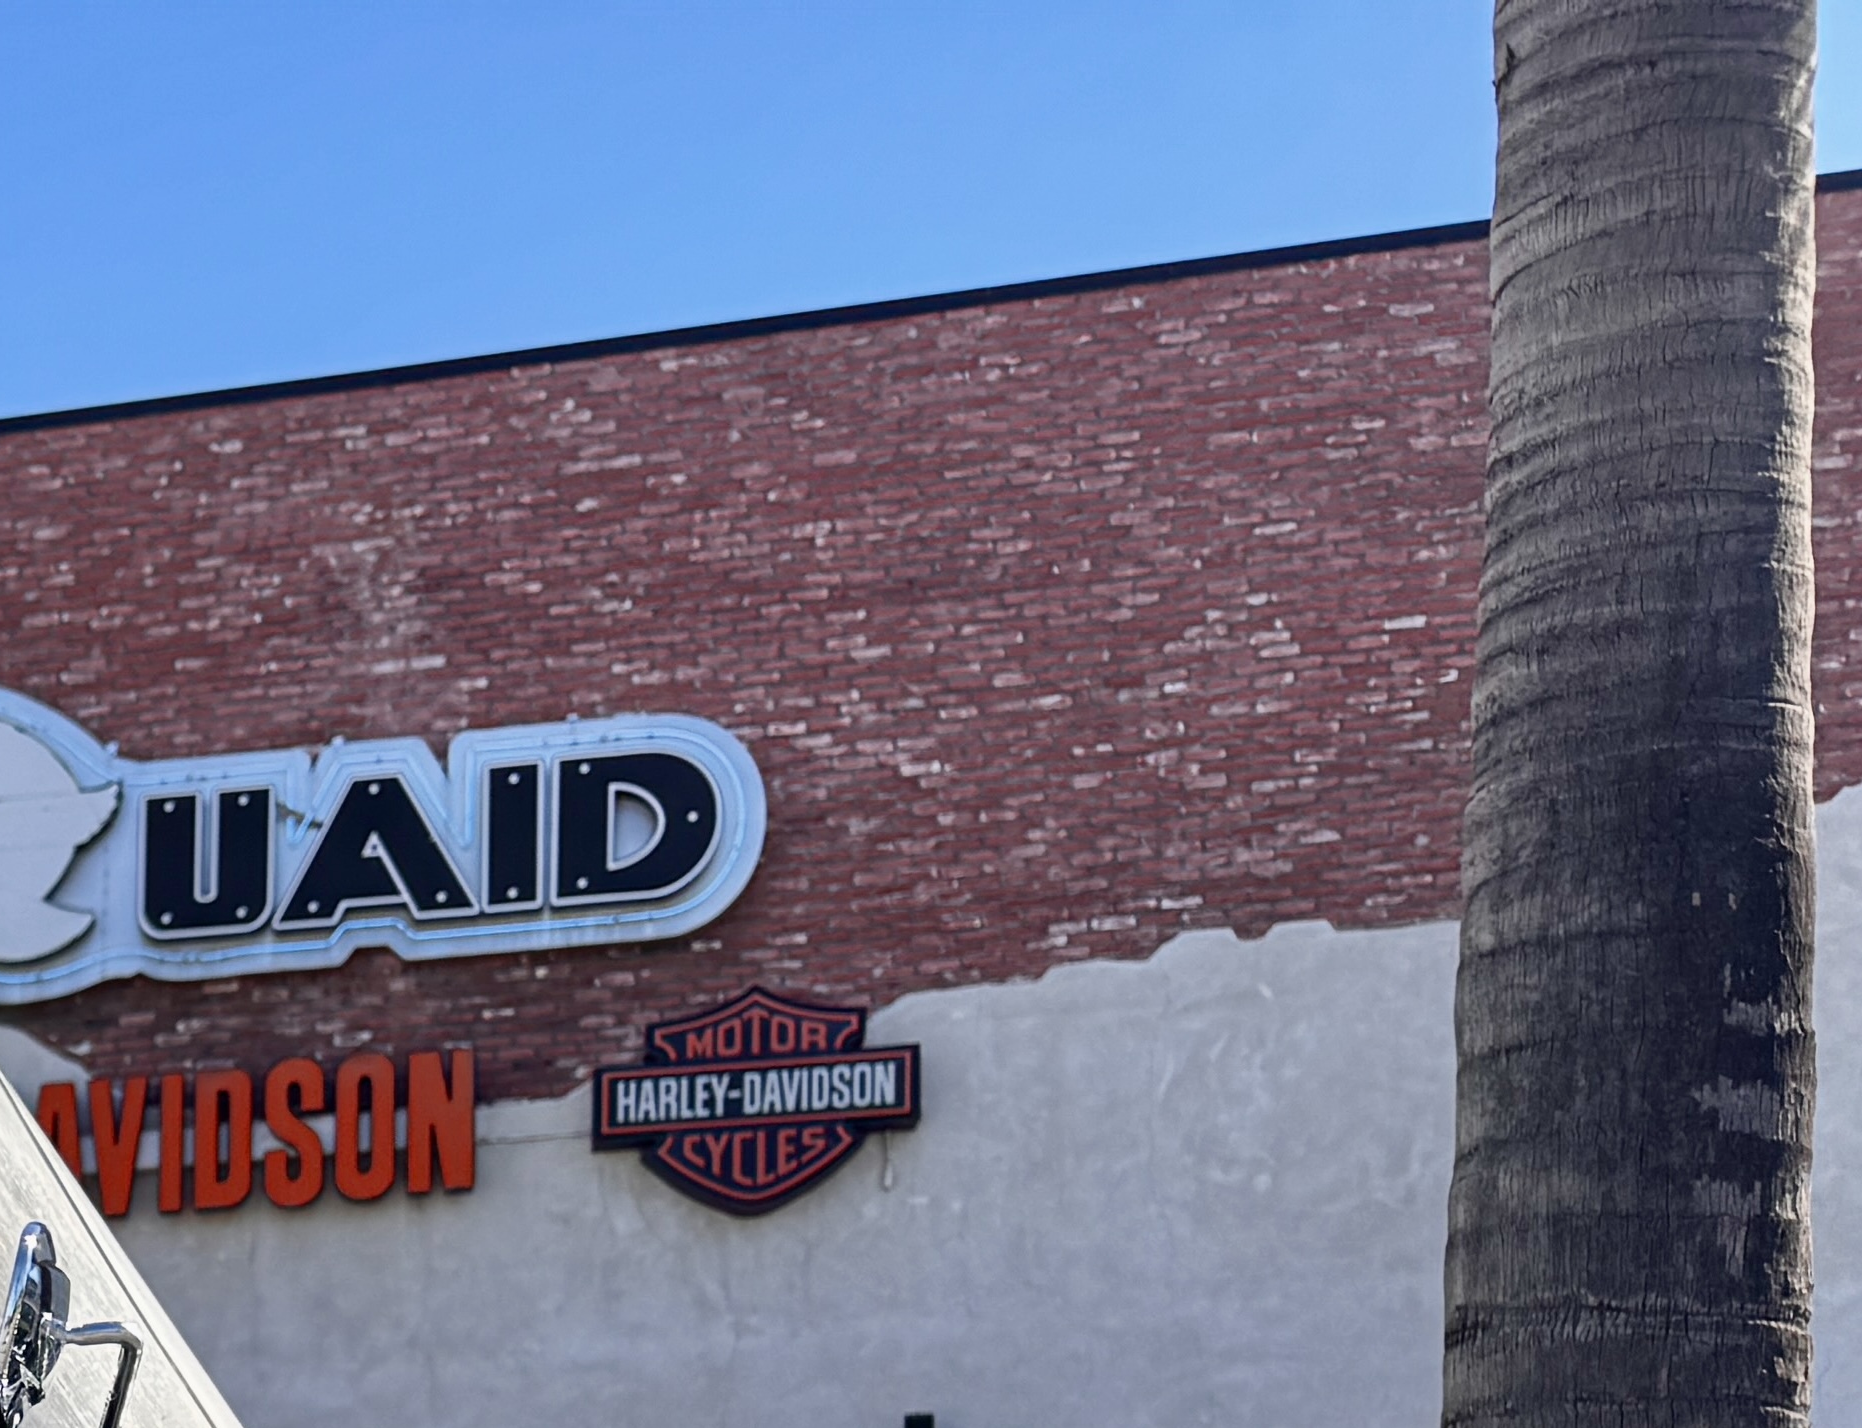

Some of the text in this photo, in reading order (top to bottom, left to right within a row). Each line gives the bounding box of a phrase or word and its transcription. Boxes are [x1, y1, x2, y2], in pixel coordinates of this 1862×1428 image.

[685, 1009, 828, 1060] MOTOR
[615, 1060, 897, 1124] HARLEY-DAVIDSON
[682, 1125, 827, 1187] CYCLES
